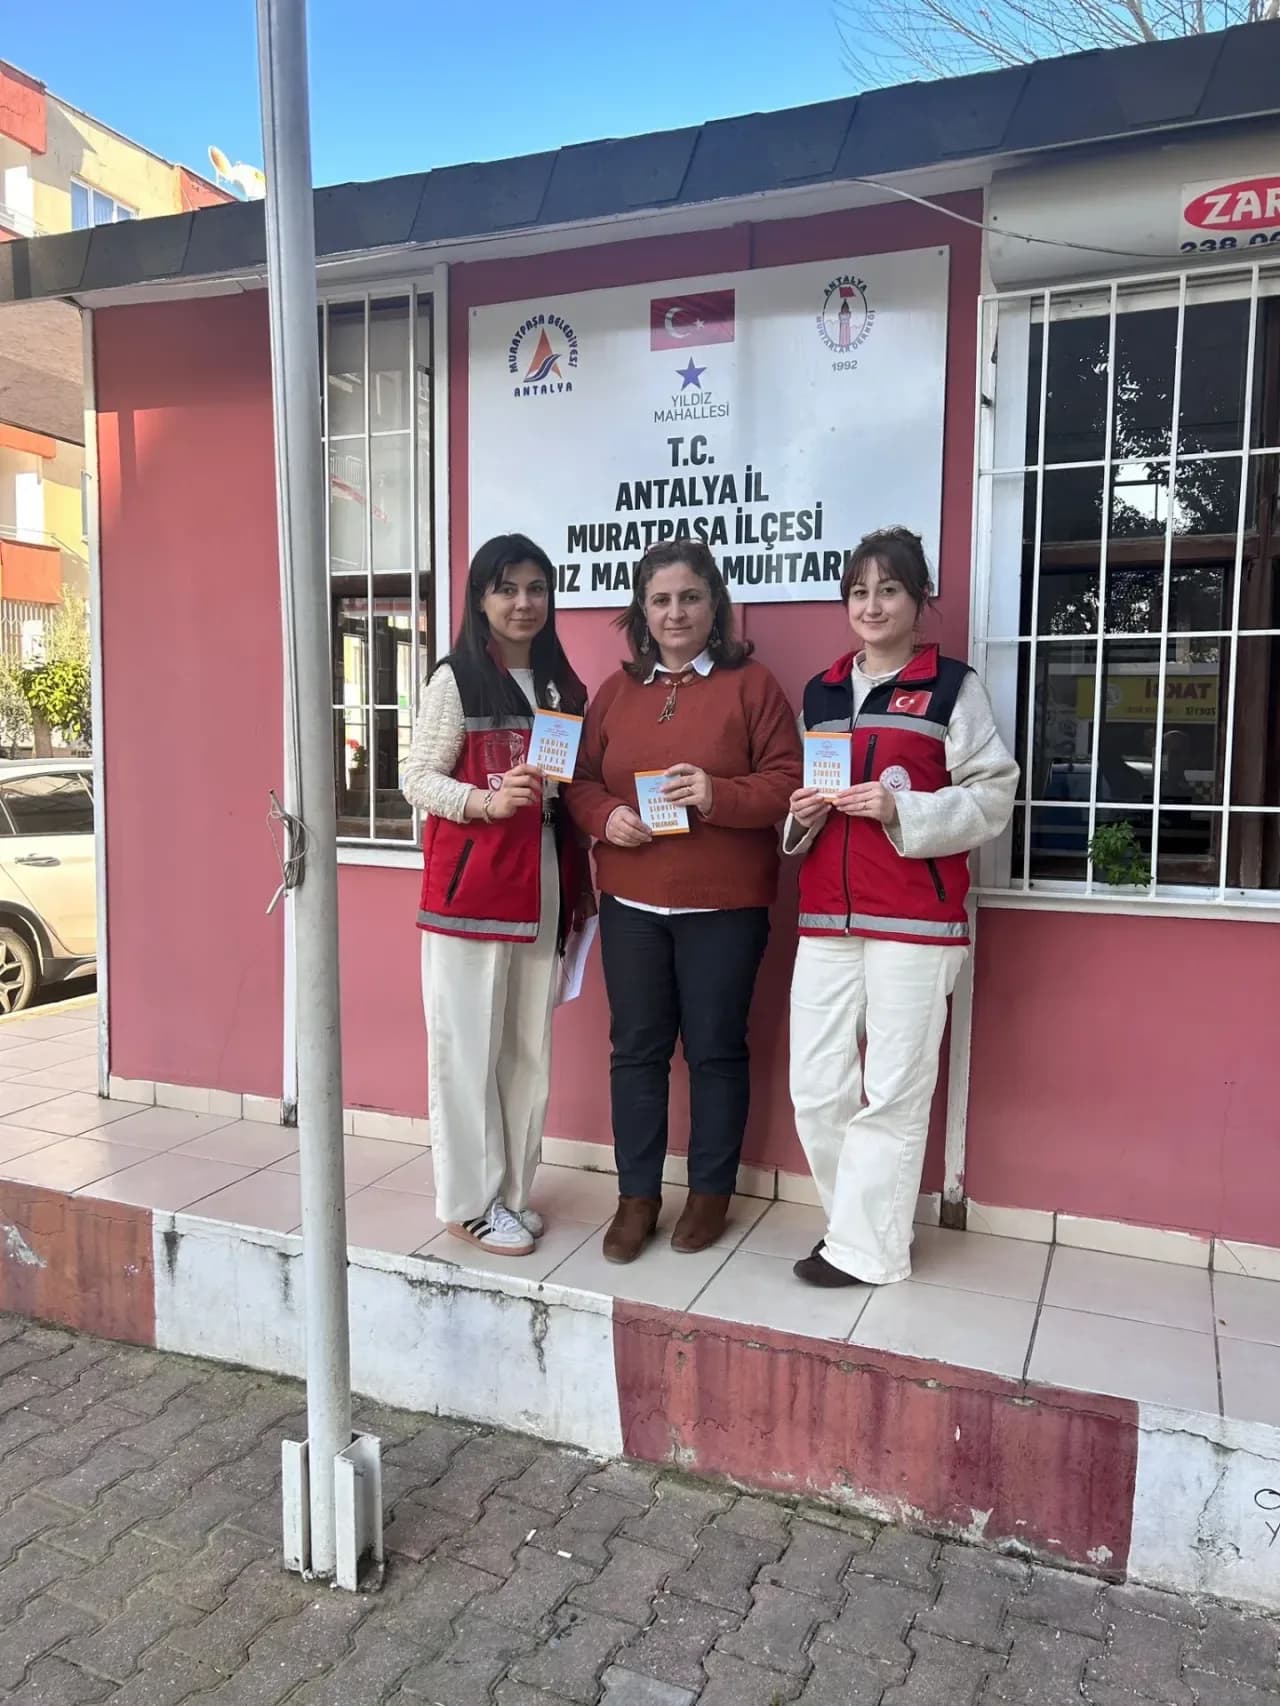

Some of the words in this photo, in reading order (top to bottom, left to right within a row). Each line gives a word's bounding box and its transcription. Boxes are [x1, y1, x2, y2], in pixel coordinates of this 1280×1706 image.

[824, 275, 868, 297] ANTALYA
[508, 314, 545, 373] MURATPAŞA
[832, 360, 858, 372] 1992
[514, 382, 573, 397] ANTALYA
[671, 391, 713, 408] YILDIZ
[654, 401, 730, 423] MAHALLESİ
[667, 435, 715, 467] T.C.
[615, 473, 738, 512] ANTALYA
[744, 464, 769, 503] İL
[735, 501, 823, 550] İLÇESİ
